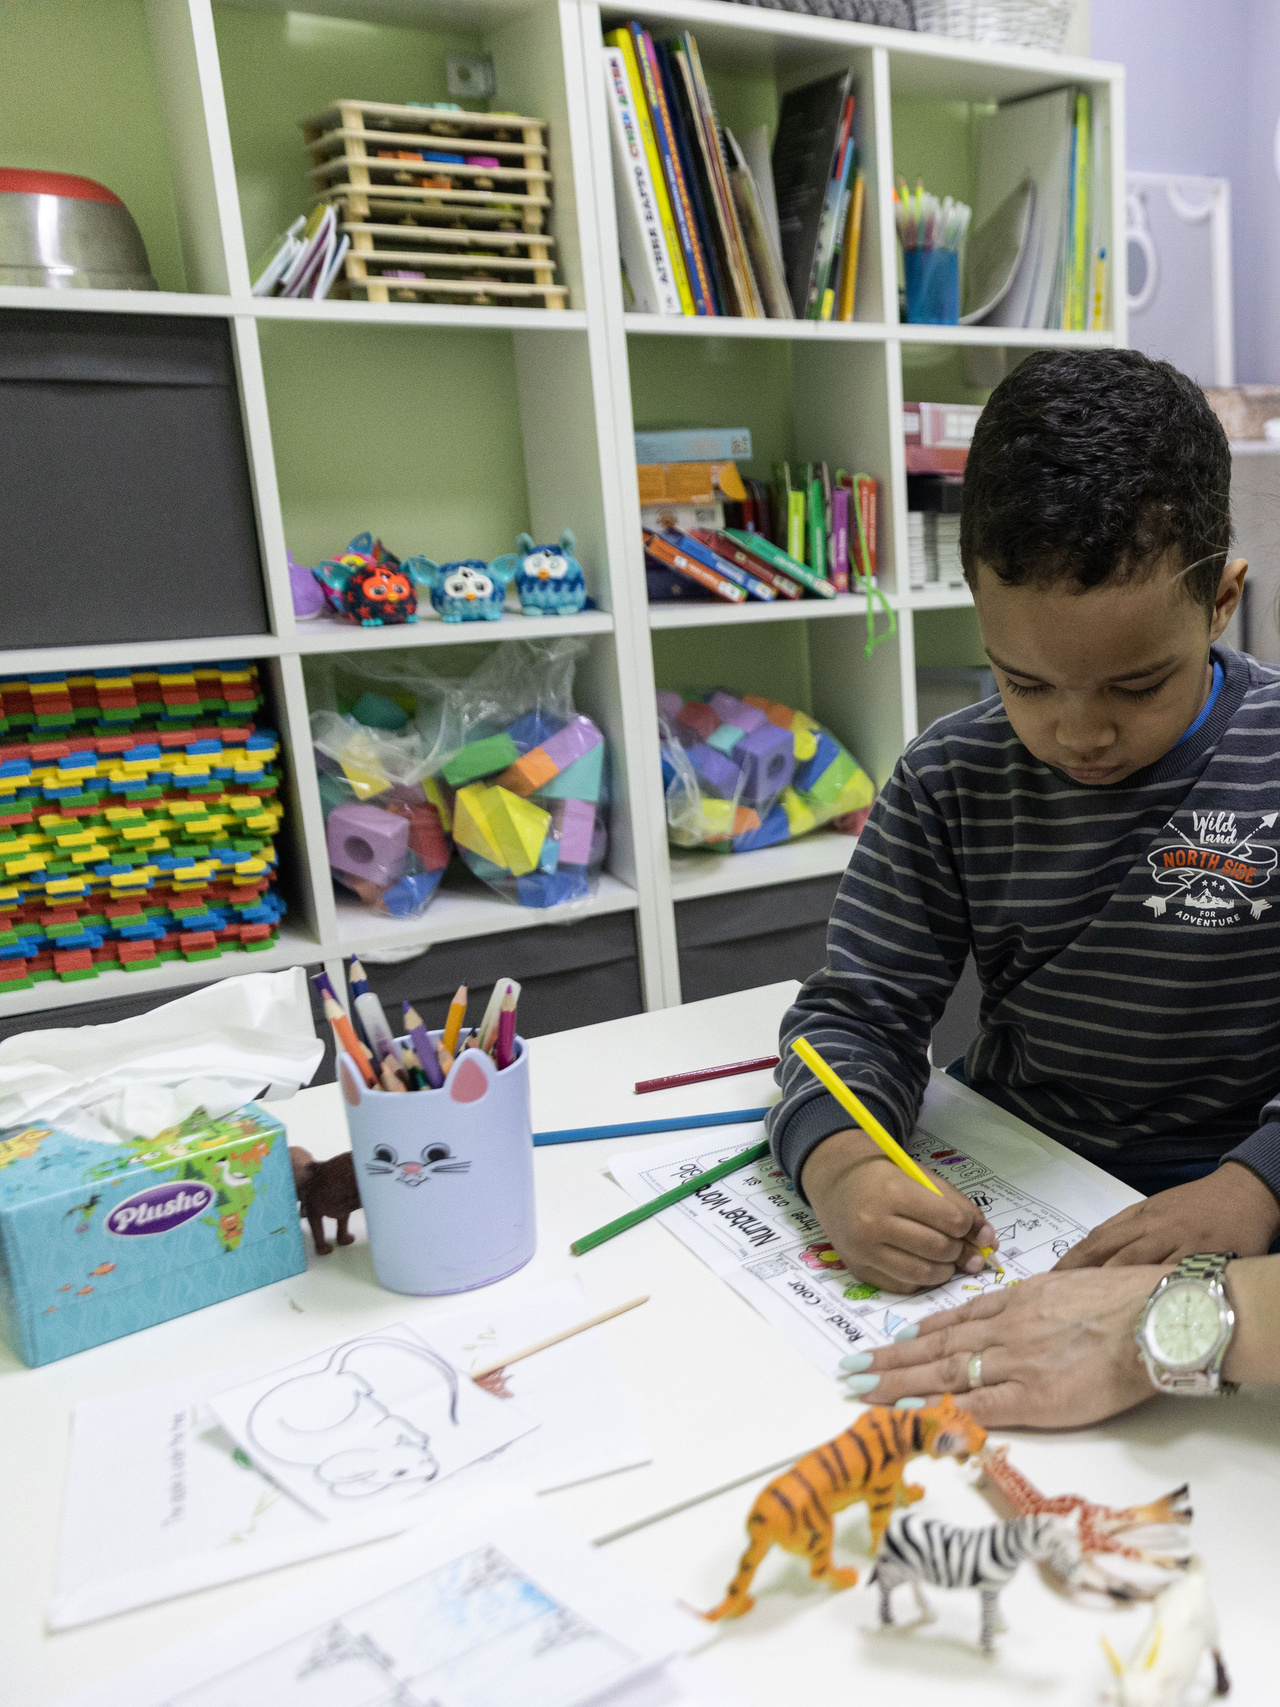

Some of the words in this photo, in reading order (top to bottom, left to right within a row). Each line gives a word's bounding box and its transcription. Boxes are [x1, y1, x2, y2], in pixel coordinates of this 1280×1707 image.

[609, 57, 628, 106] ДЕТЯМ
[621, 109, 639, 158] СТИХИ
[633, 165, 653, 222] БАРТО
[649, 229, 669, 285] АГНИЯ
[1193, 811, 1236, 832] Wild
[1200, 828, 1237, 844] Land
[1163, 849, 1220, 871] NORTH
[1221, 859, 1257, 883] SIDE
[1175, 910, 1241, 927] ADVENTURE
[1200, 910, 1216, 918] FOR
[670, 1163, 704, 1185] ab
[742, 1176, 762, 1186] six
[113, 1190, 208, 1231] Plushe
[768, 1194, 790, 1207] one
[719, 1207, 781, 1247] Number
[791, 1211, 821, 1232] three
[787, 1281, 821, 1305] Color
[825, 1314, 865, 1343] Read
